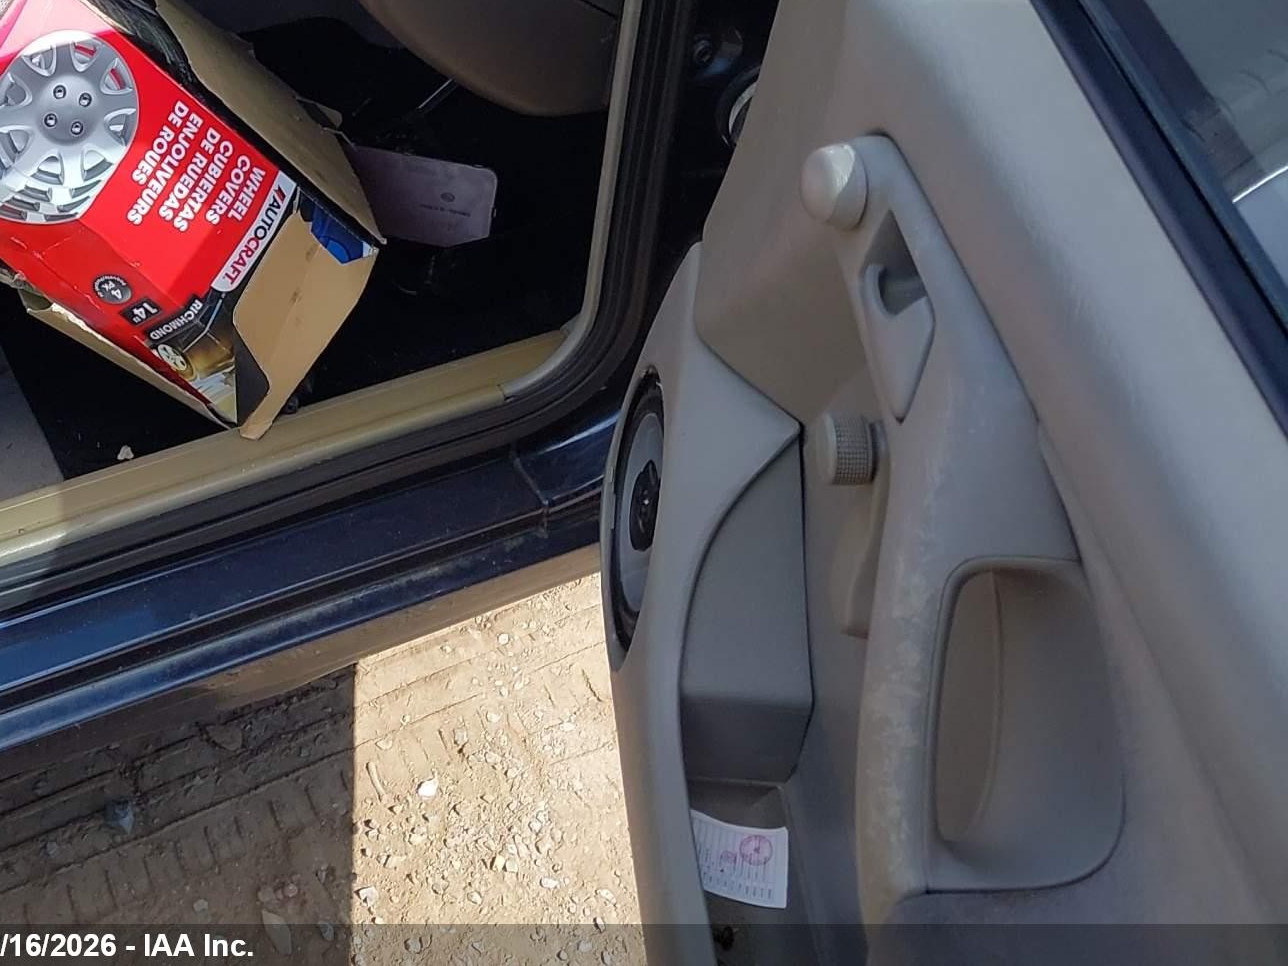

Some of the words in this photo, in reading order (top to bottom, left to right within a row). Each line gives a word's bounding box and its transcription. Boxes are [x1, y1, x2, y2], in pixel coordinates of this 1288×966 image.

[167, 100, 190, 129] DE
[200, 127, 222, 155] DE
[126, 112, 204, 226] ENJOLIVEURS
[131, 126, 176, 186] ROUES
[158, 151, 209, 222] RUEDAS
[173, 140, 234, 233] CUBIERTAS
[205, 154, 251, 226] COVERS
[227, 166, 266, 223] WHEEL
[224, 198, 283, 286] AUTOCRAFT
[110, 289, 123, 300] 4
[132, 302, 159, 324] 14"
[149, 299, 204, 340] RICHMOND
